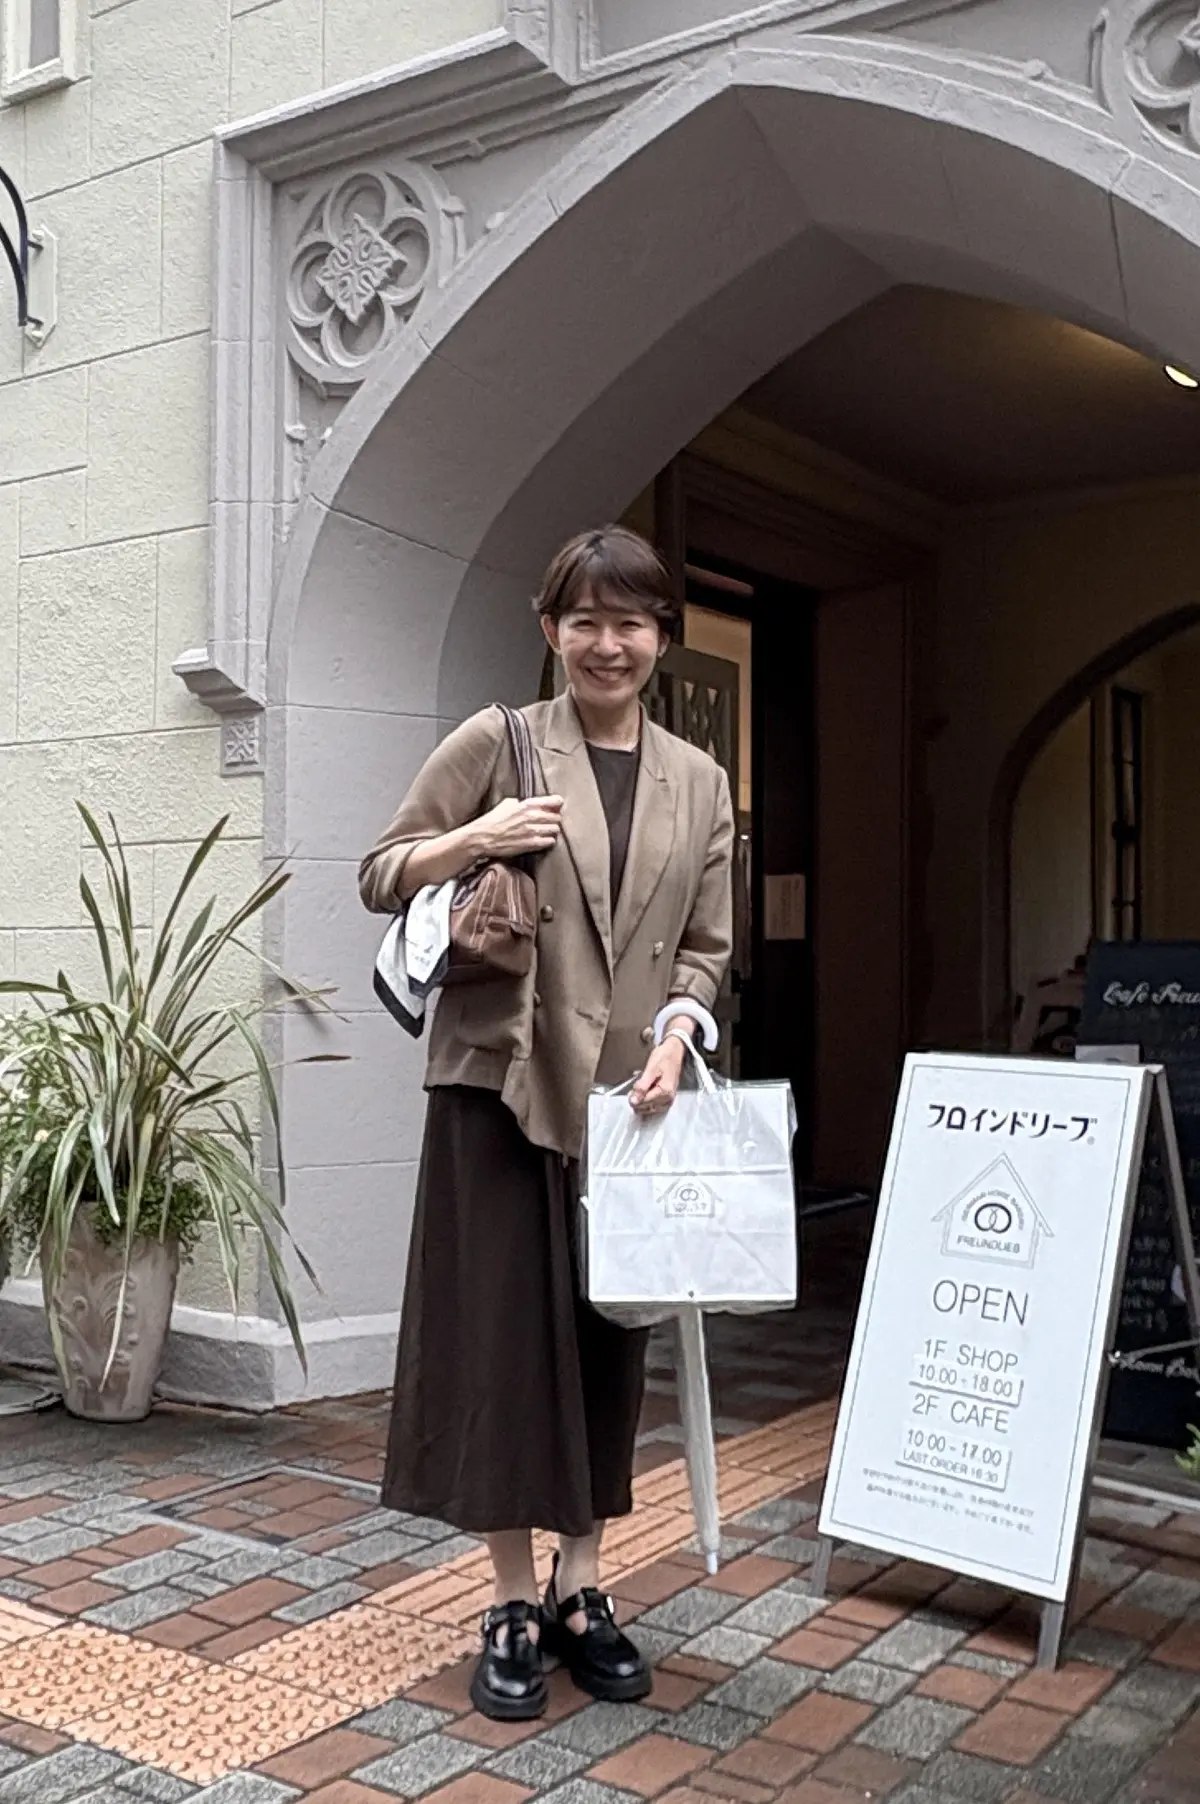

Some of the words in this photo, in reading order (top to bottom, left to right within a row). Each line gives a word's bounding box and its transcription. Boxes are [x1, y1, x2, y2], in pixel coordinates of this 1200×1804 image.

[927, 1103, 1098, 1142] フロインドリーブ
[932, 1279, 1029, 1325] OPEN
[924, 1338, 948, 1359] 1F
[956, 1343, 1018, 1373] SHOP
[912, 1392, 940, 1415] 2F
[950, 1399, 1010, 1435] CAFE
[902, 1447, 928, 1465] LAST
[929, 1454, 968, 1475] ORDER
